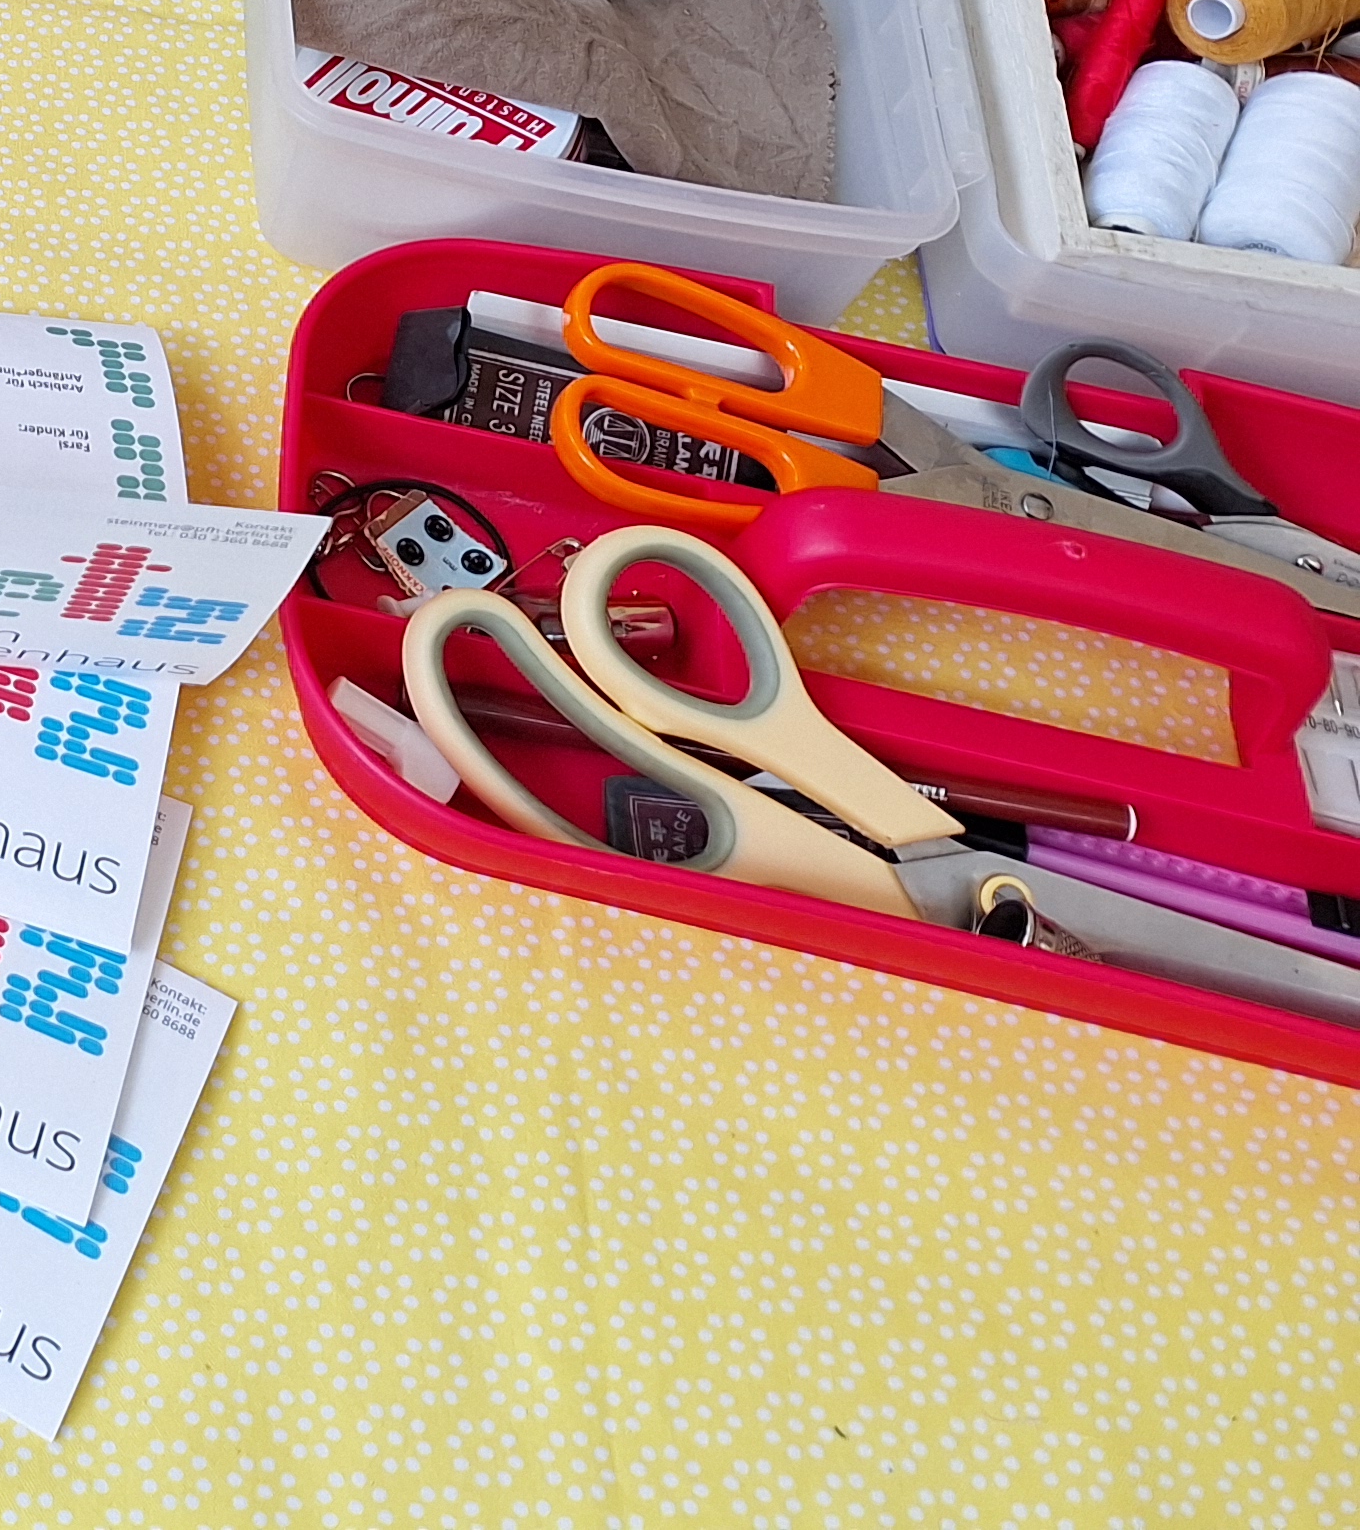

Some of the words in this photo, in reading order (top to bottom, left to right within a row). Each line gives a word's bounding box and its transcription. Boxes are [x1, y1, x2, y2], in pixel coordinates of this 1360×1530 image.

[310, 56, 526, 151] ulmoll
[5, 377, 24, 388] für
[28, 379, 83, 393] Arabisch
[466, 363, 483, 395] MADE
[464, 397, 476, 410] IN
[492, 369, 525, 417] SIZE
[532, 378, 552, 414] STEEL
[17, 423, 66, 438] Kinder:
[69, 429, 89, 441] für
[161, 1014, 197, 1041] 8688
